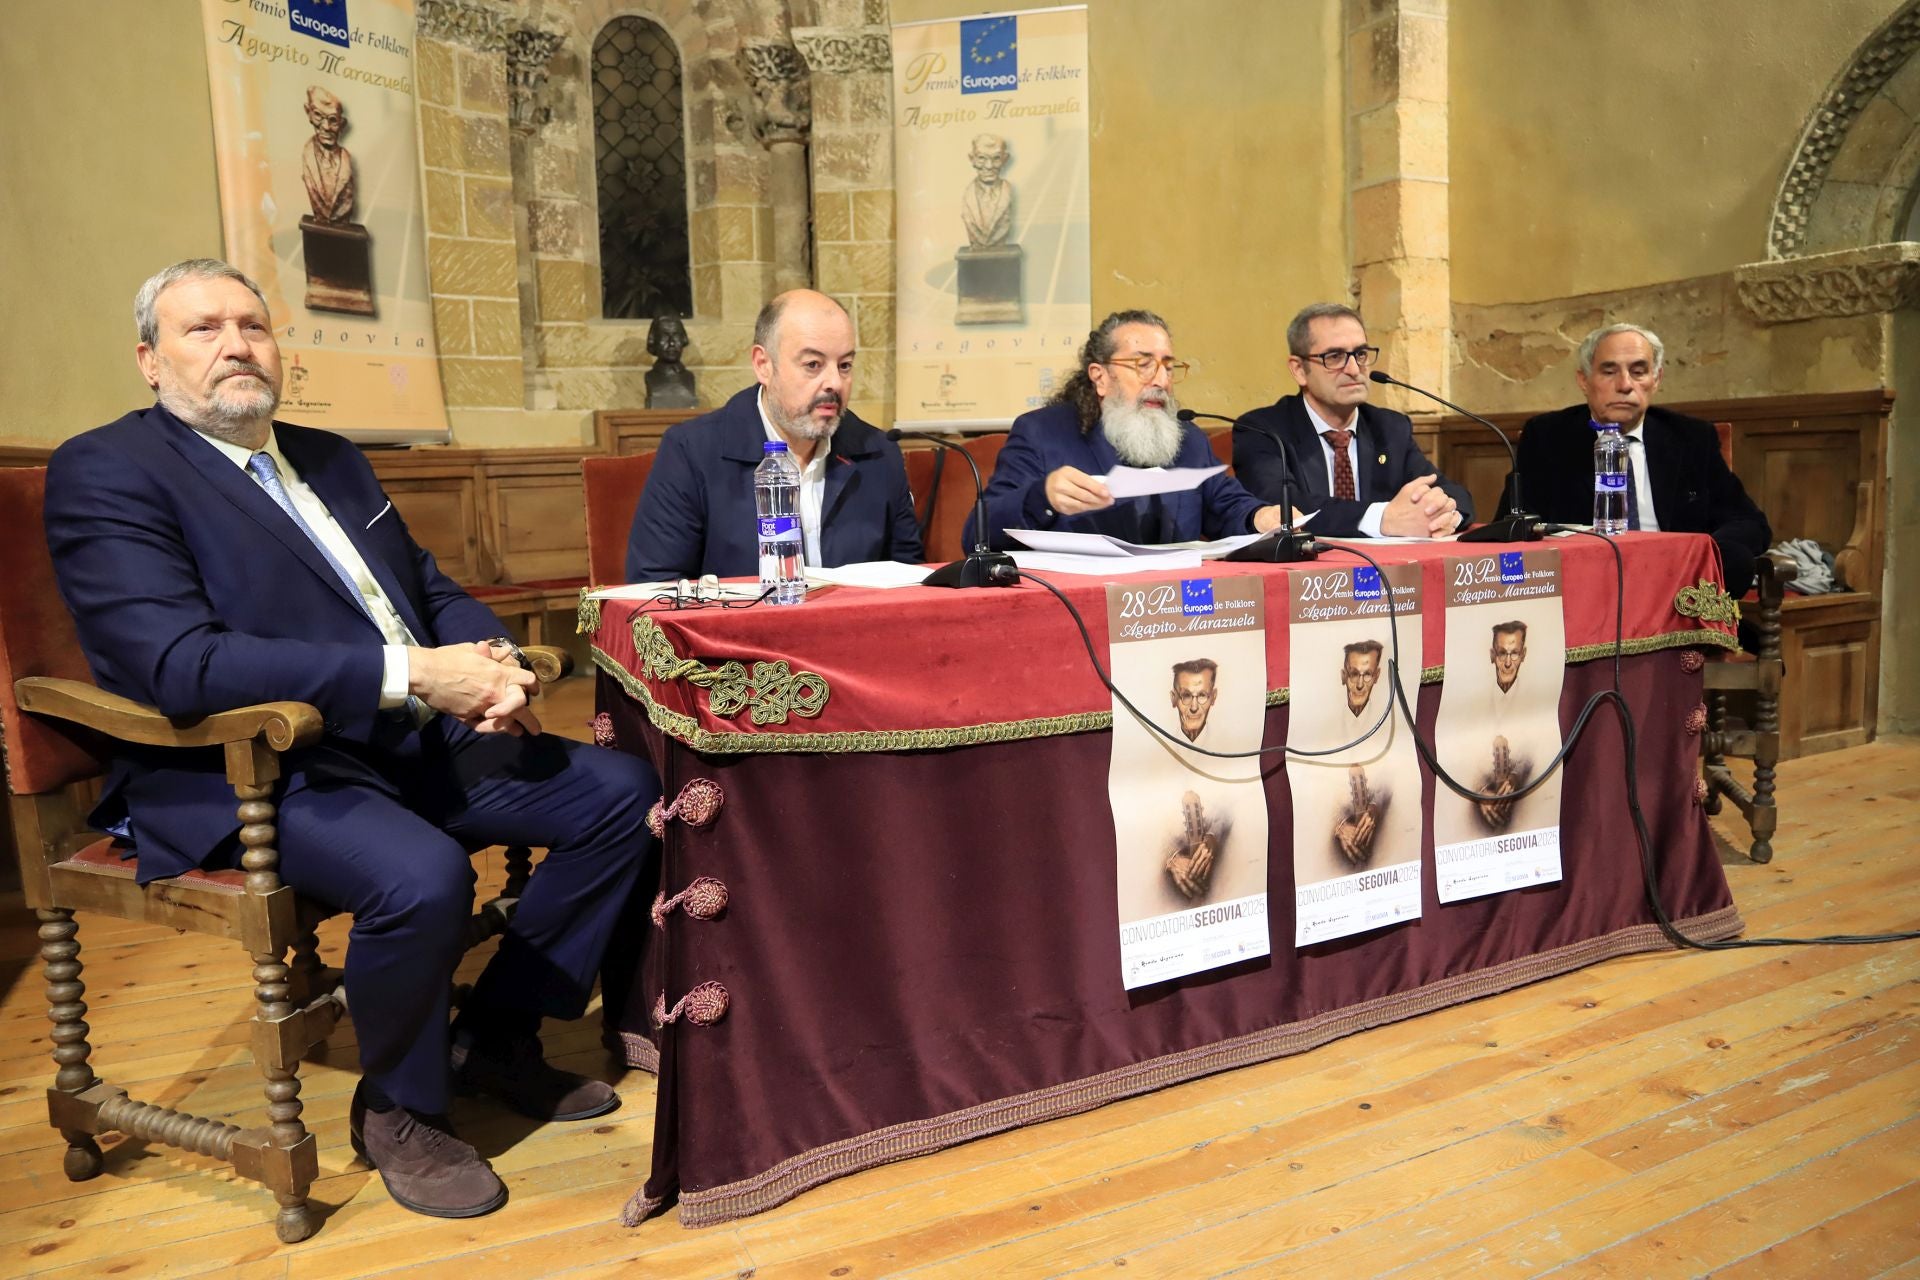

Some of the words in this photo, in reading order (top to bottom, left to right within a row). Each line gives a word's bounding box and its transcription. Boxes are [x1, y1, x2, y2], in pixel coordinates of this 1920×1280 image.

[291, 9, 348, 40] Europeo
[350, 27, 363, 44] de
[367, 31, 409, 58] Folklore
[218, 19, 309, 66] Agapito
[317, 50, 412, 95] Marazuela
[903, 52, 958, 94] Premio
[963, 75, 1017, 89] Europeo
[1018, 68, 1032, 83] de
[1035, 67, 1081, 82] Folklore
[901, 106, 976, 129] Agapito
[984, 97, 1081, 120] Marazuela
[287, 326, 425, 347] egovia
[1299, 576, 1322, 601] 28
[1324, 572, 1354, 599] Premio
[1354, 589, 1380, 599] Europeo
[1392, 586, 1416, 595] Folklore
[1454, 562, 1473, 587] 28
[1474, 558, 1501, 584] Premio
[1501, 573, 1524, 582] Europeo
[1524, 571, 1531, 579] de
[1532, 570, 1555, 578] Folklore
[1120, 590, 1145, 618] 28
[1147, 585, 1183, 615] Premio
[1184, 604, 1213, 614] Europeo
[1214, 601, 1223, 610] de
[1224, 599, 1256, 609] Folklore
[1453, 588, 1497, 604] Agapito
[1498, 582, 1555, 598] Marazuela
[1119, 620, 1177, 639] Agapito
[1179, 613, 1256, 632] Marazuela
[1299, 603, 1348, 621] Agapito
